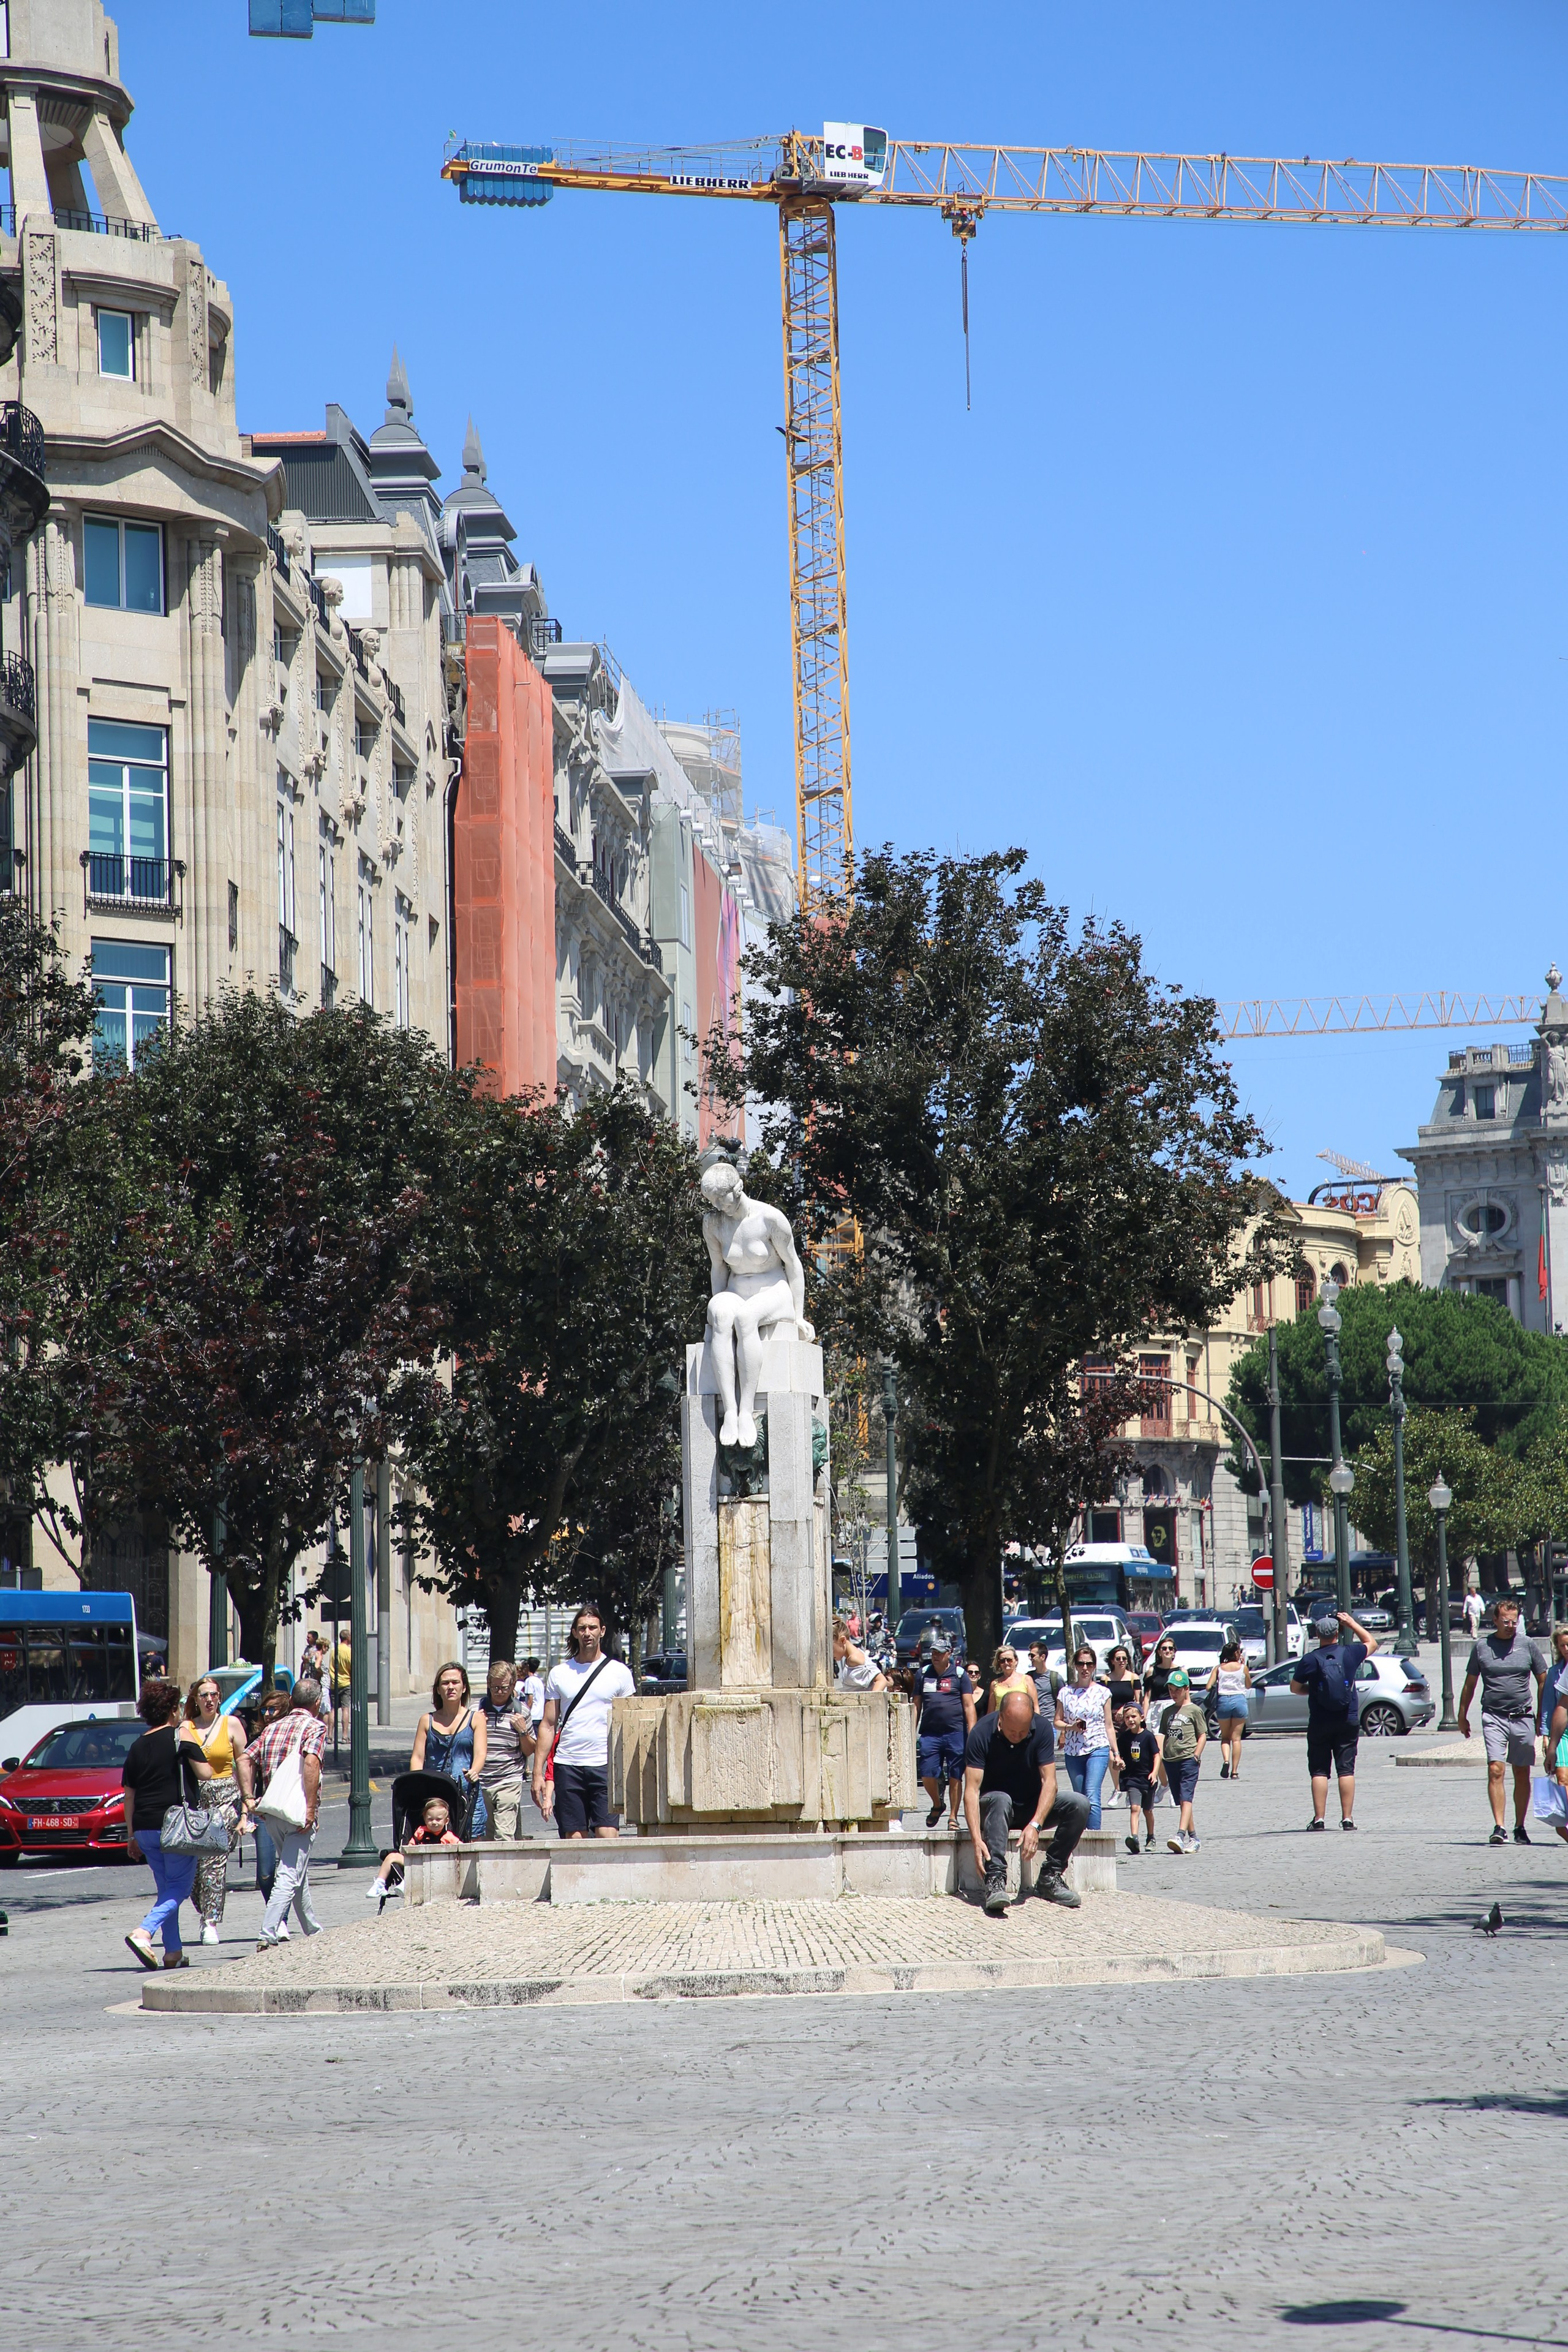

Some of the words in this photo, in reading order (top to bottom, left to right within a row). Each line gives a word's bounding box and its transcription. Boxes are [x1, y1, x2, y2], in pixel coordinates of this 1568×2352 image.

[825, 143, 863, 160] EC-B
[470, 160, 537, 174] GrumonTe
[672, 175, 748, 189] LIEBHERR
[81, 1605, 91, 1613] 1733
